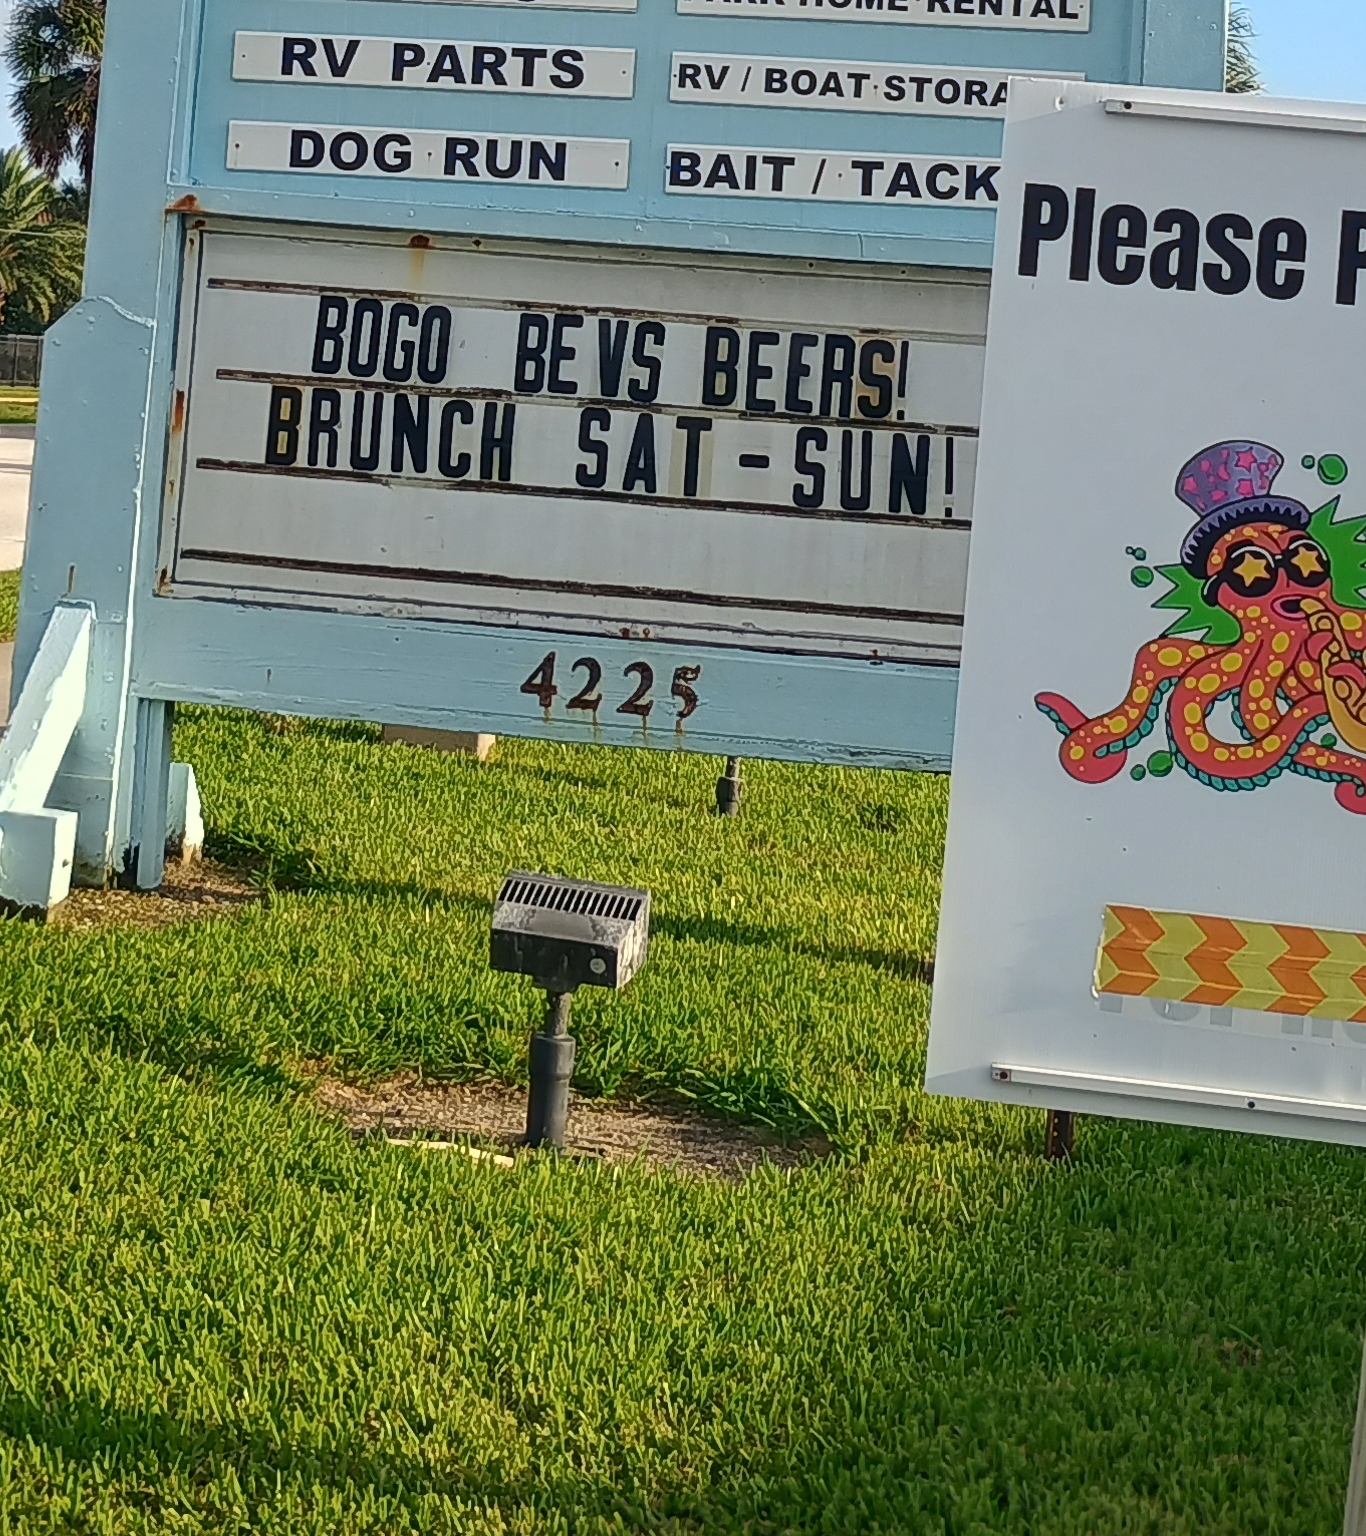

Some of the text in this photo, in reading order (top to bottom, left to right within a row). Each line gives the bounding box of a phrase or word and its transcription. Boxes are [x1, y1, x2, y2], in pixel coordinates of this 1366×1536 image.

[280, 37, 585, 89] RV PARTS
[678, 63, 730, 90] RV
[764, 68, 871, 98] BOAT
[884, 75, 1008, 107] STORA
[289, 129, 567, 181] DOG RUN
[668, 151, 796, 192] BAIT
[851, 160, 1002, 202] TACK
[1017, 181, 1308, 301] Please
[311, 295, 451, 384] BOGO
[701, 326, 911, 421] BEERS!
[264, 385, 516, 483] BRUNCH
[520, 650, 701, 720] 4225
